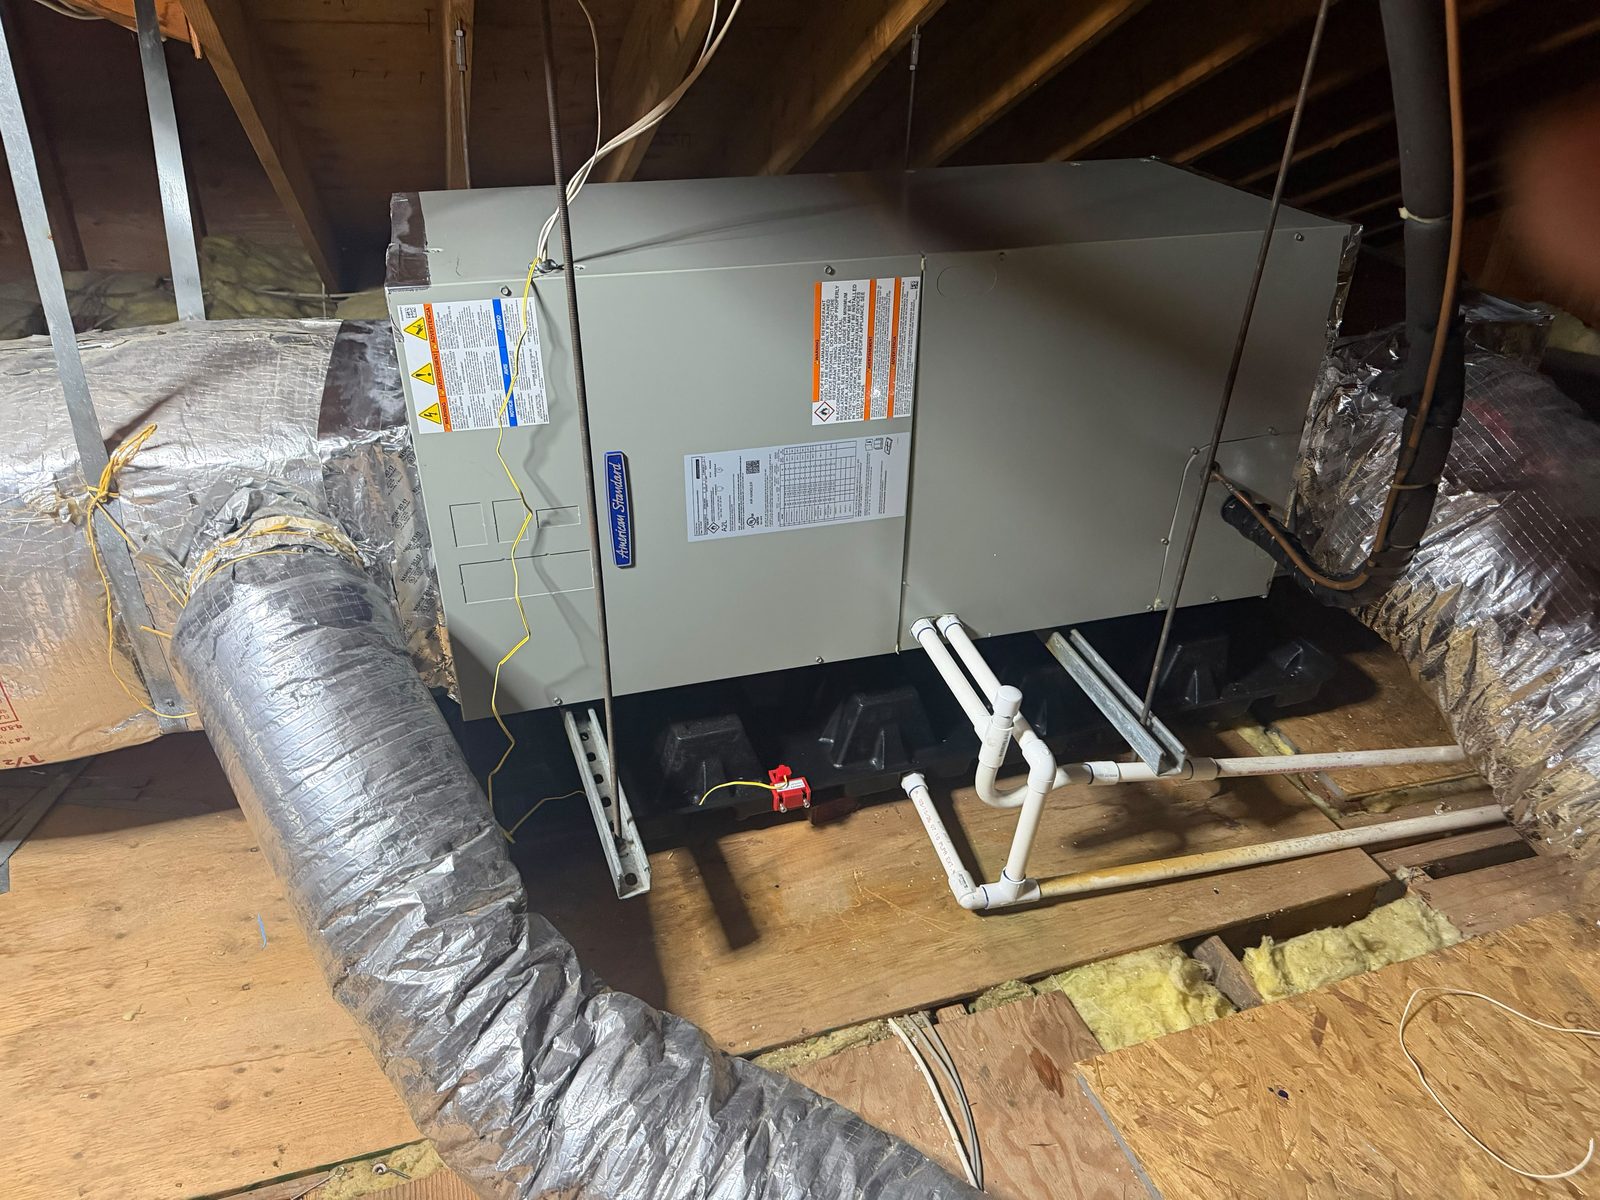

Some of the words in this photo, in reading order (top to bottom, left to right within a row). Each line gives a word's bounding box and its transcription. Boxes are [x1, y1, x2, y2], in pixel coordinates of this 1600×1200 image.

[426, 307, 436, 343] ADVERTENCIA
[609, 462, 624, 512] Standard
[616, 515, 629, 558] American
